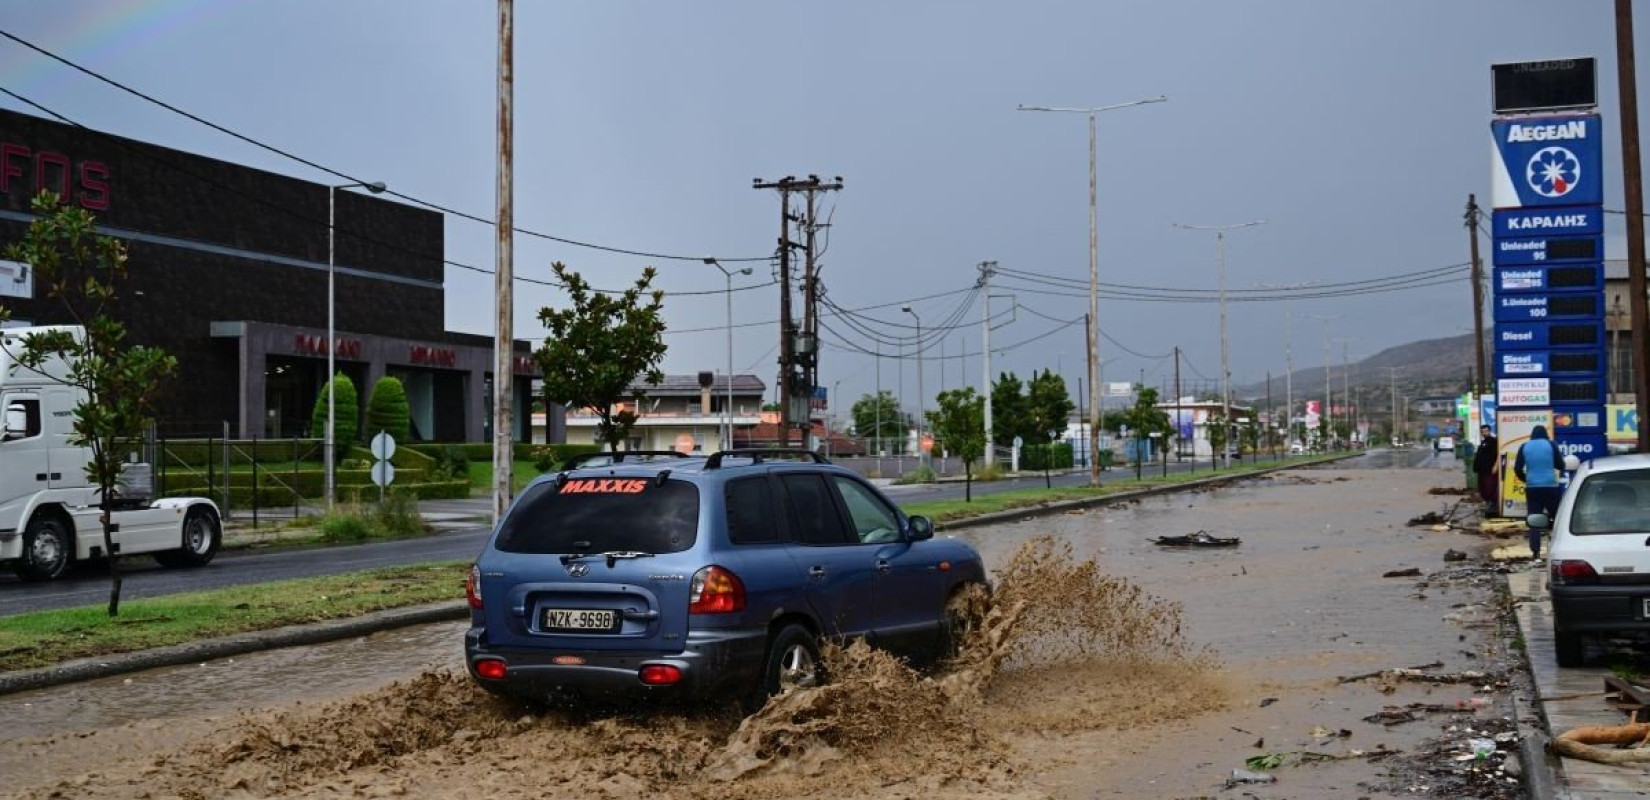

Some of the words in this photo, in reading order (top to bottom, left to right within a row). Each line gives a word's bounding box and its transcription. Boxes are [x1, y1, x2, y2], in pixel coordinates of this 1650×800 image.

[1508, 215, 1587, 229] ΚΑΡΑΛΗΣ
[1501, 240, 1546, 250] Unleaded
[1533, 251, 1546, 260] 95
[1501, 270, 1542, 279] Unleaded
[1530, 308, 1547, 317] 100
[1503, 331, 1532, 341] Diesel
[1503, 355, 1531, 363] Diesel
[1501, 395, 1547, 403] AUTOGAS
[560, 480, 647, 493] MAXXIS
[549, 611, 611, 628] NZK-9698
